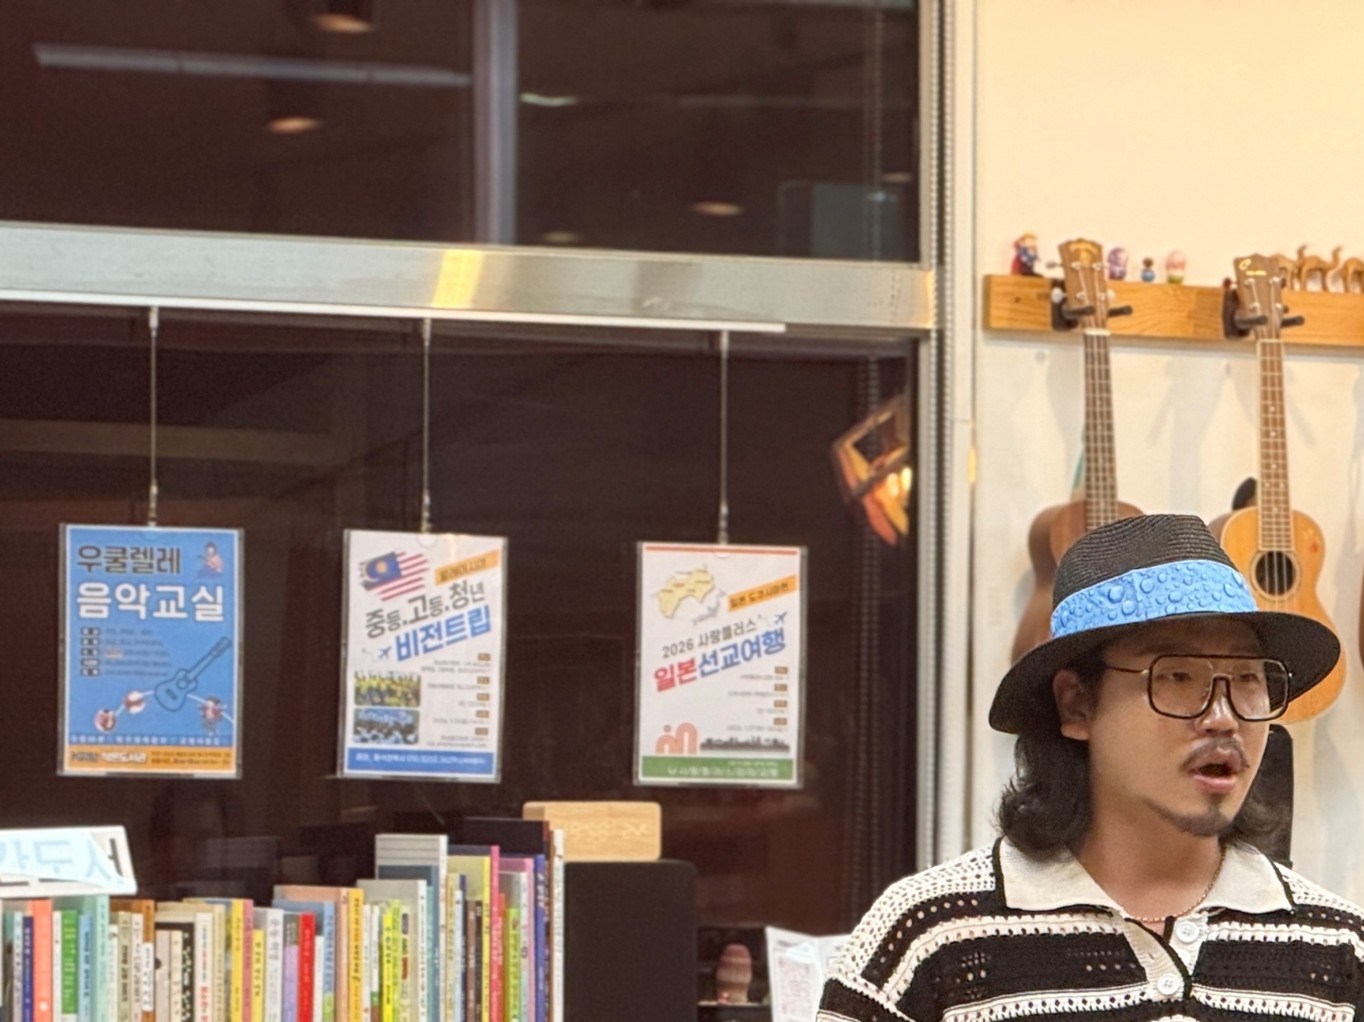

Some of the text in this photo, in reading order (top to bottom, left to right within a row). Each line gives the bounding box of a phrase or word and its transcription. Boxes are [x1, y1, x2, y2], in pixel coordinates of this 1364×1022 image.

[77, 545, 181, 575] 우쿨렐레
[76, 581, 225, 622] 음악교실
[395, 604, 492, 663] 비전트립
[662, 637, 695, 659] 2026
